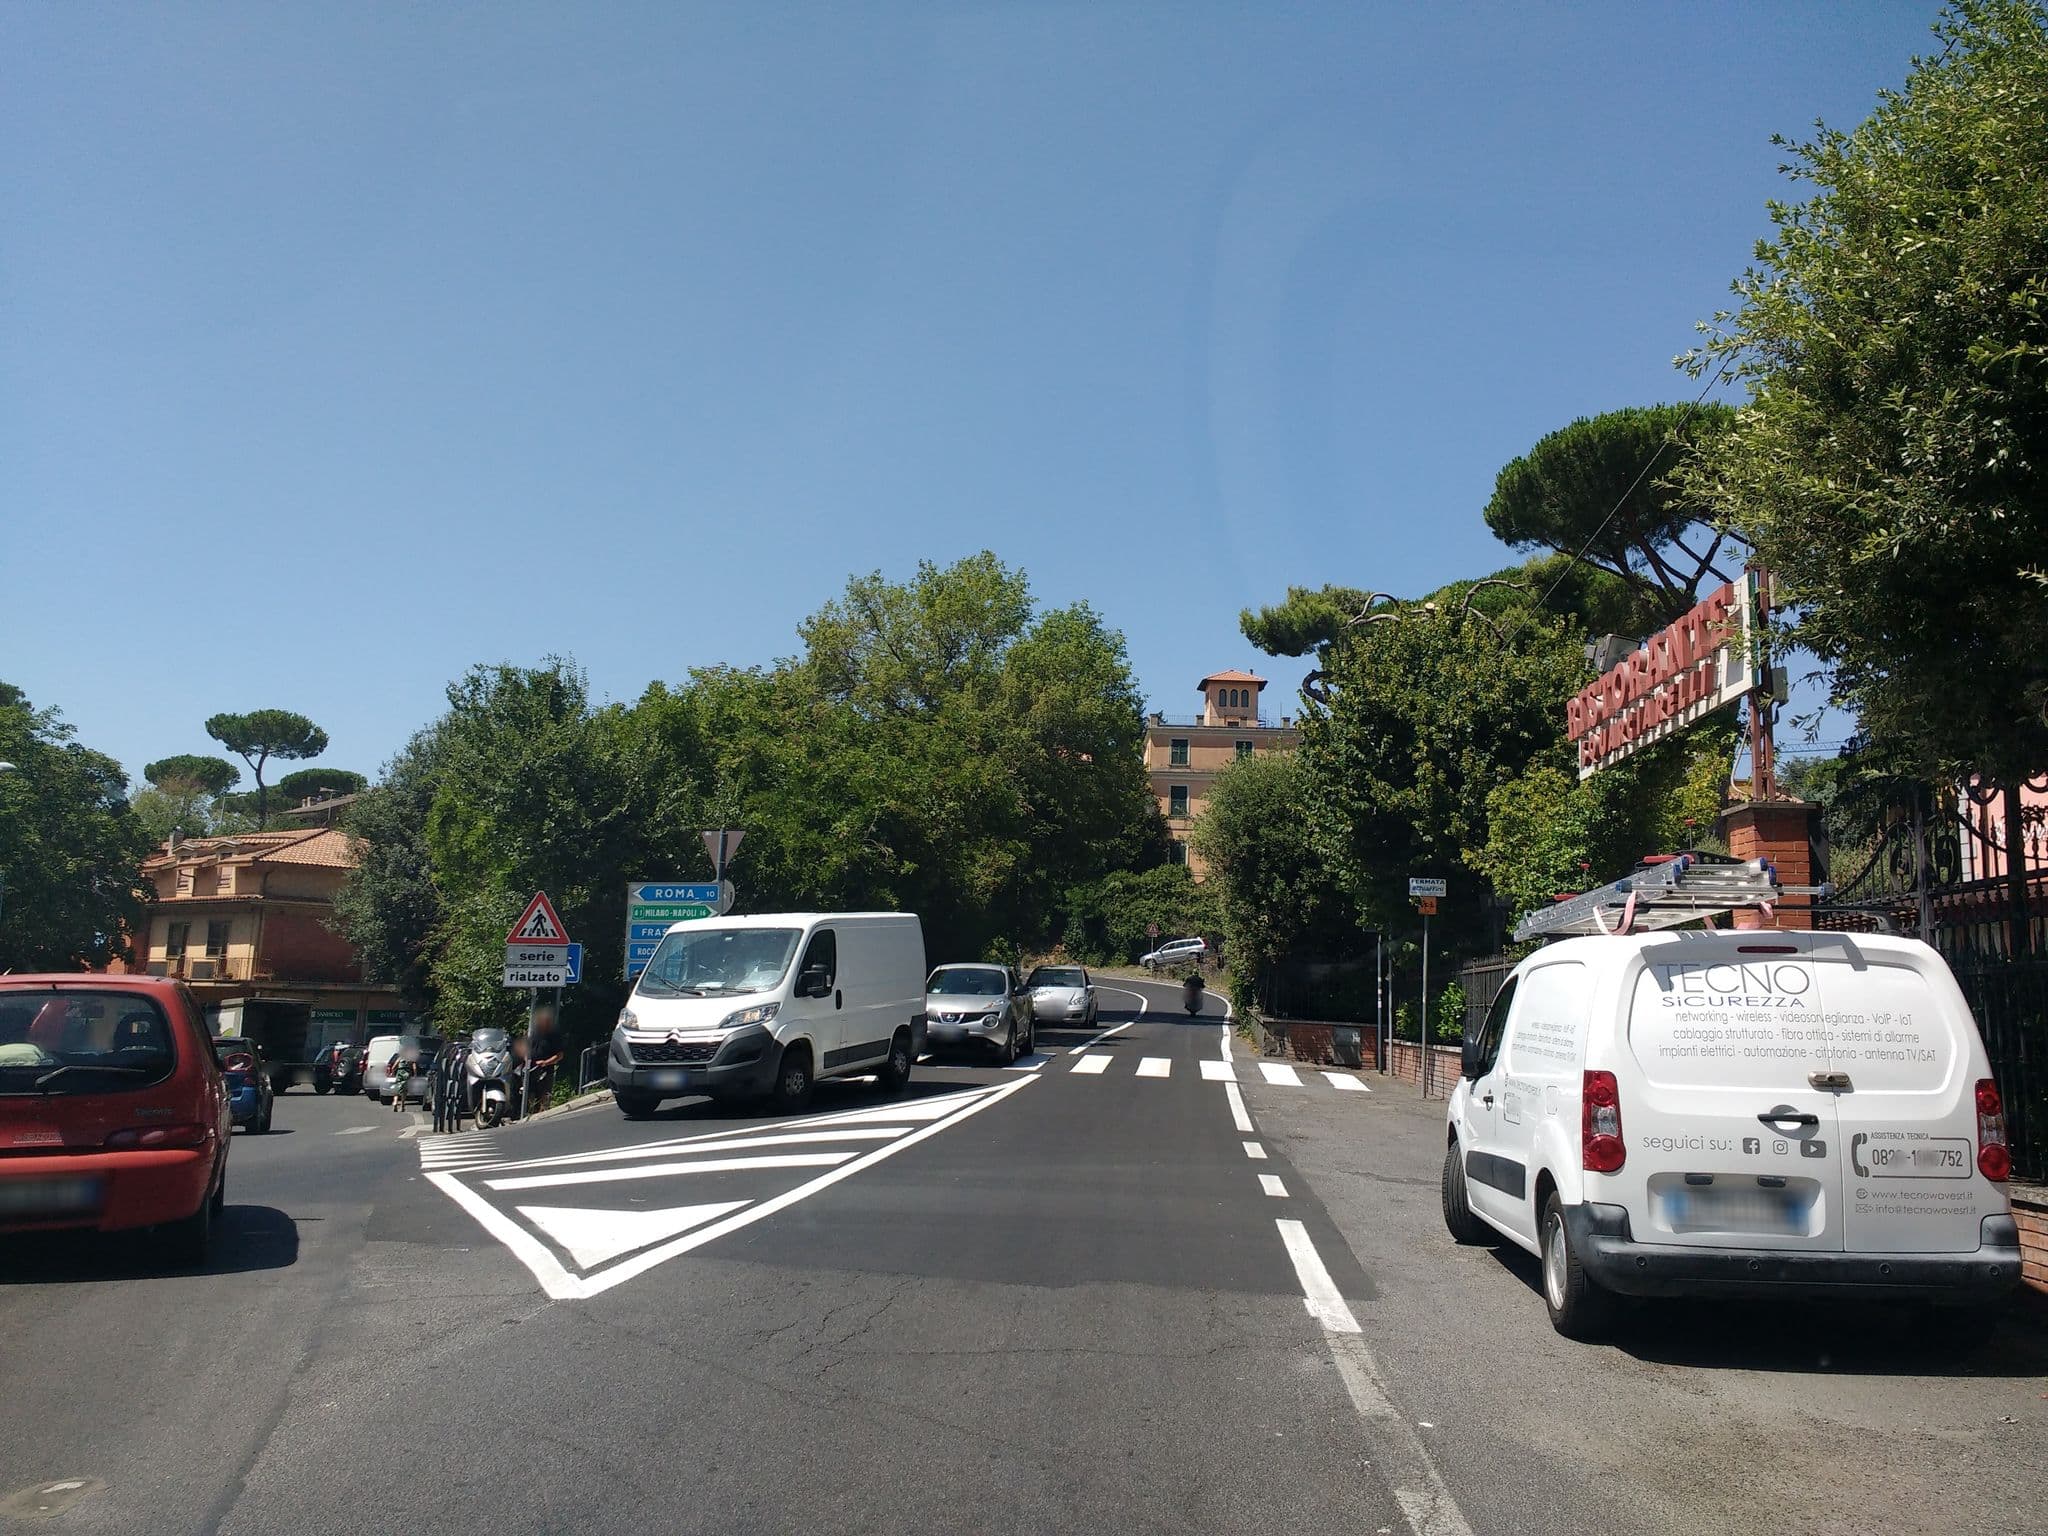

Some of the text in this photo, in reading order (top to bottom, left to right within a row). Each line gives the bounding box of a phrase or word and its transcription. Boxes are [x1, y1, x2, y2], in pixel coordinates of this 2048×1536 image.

[1566, 583, 1744, 742] RISTORANTE
[655, 888, 716, 899] ROMA 10
[645, 908, 697, 917] MILANO-NAPOLI
[520, 950, 555, 961] serie
[510, 971, 560, 982] rialzato
[1657, 963, 1810, 995] TECNO
[1675, 1010, 1729, 1024] networking
[1736, 1011, 1772, 1022] wireless
[1673, 1028, 1723, 1041] cablaggio
[1725, 1029, 1774, 1040] strutturato
[1781, 1028, 1803, 1040] fibra
[1805, 1030, 1834, 1041] ottica
[1841, 1030, 1872, 1042] sistemi
[1874, 1031, 1884, 1043] di
[1885, 1032, 1920, 1044] allarme
[1659, 1045, 1699, 1058] impianti
[1700, 1046, 1736, 1057] elettrici
[1743, 1047, 1807, 1058] automazione
[1864, 1048, 1905, 1061] antenna
[1870, 1132, 1929, 1140] ASSISTENZA TECNICA
[1643, 1135, 1733, 1151] seguici su:
[1872, 1190, 1973, 1201] www.tecnowavesrl.it
[1875, 1203, 1977, 1215] info@tecnowavesrl.it
